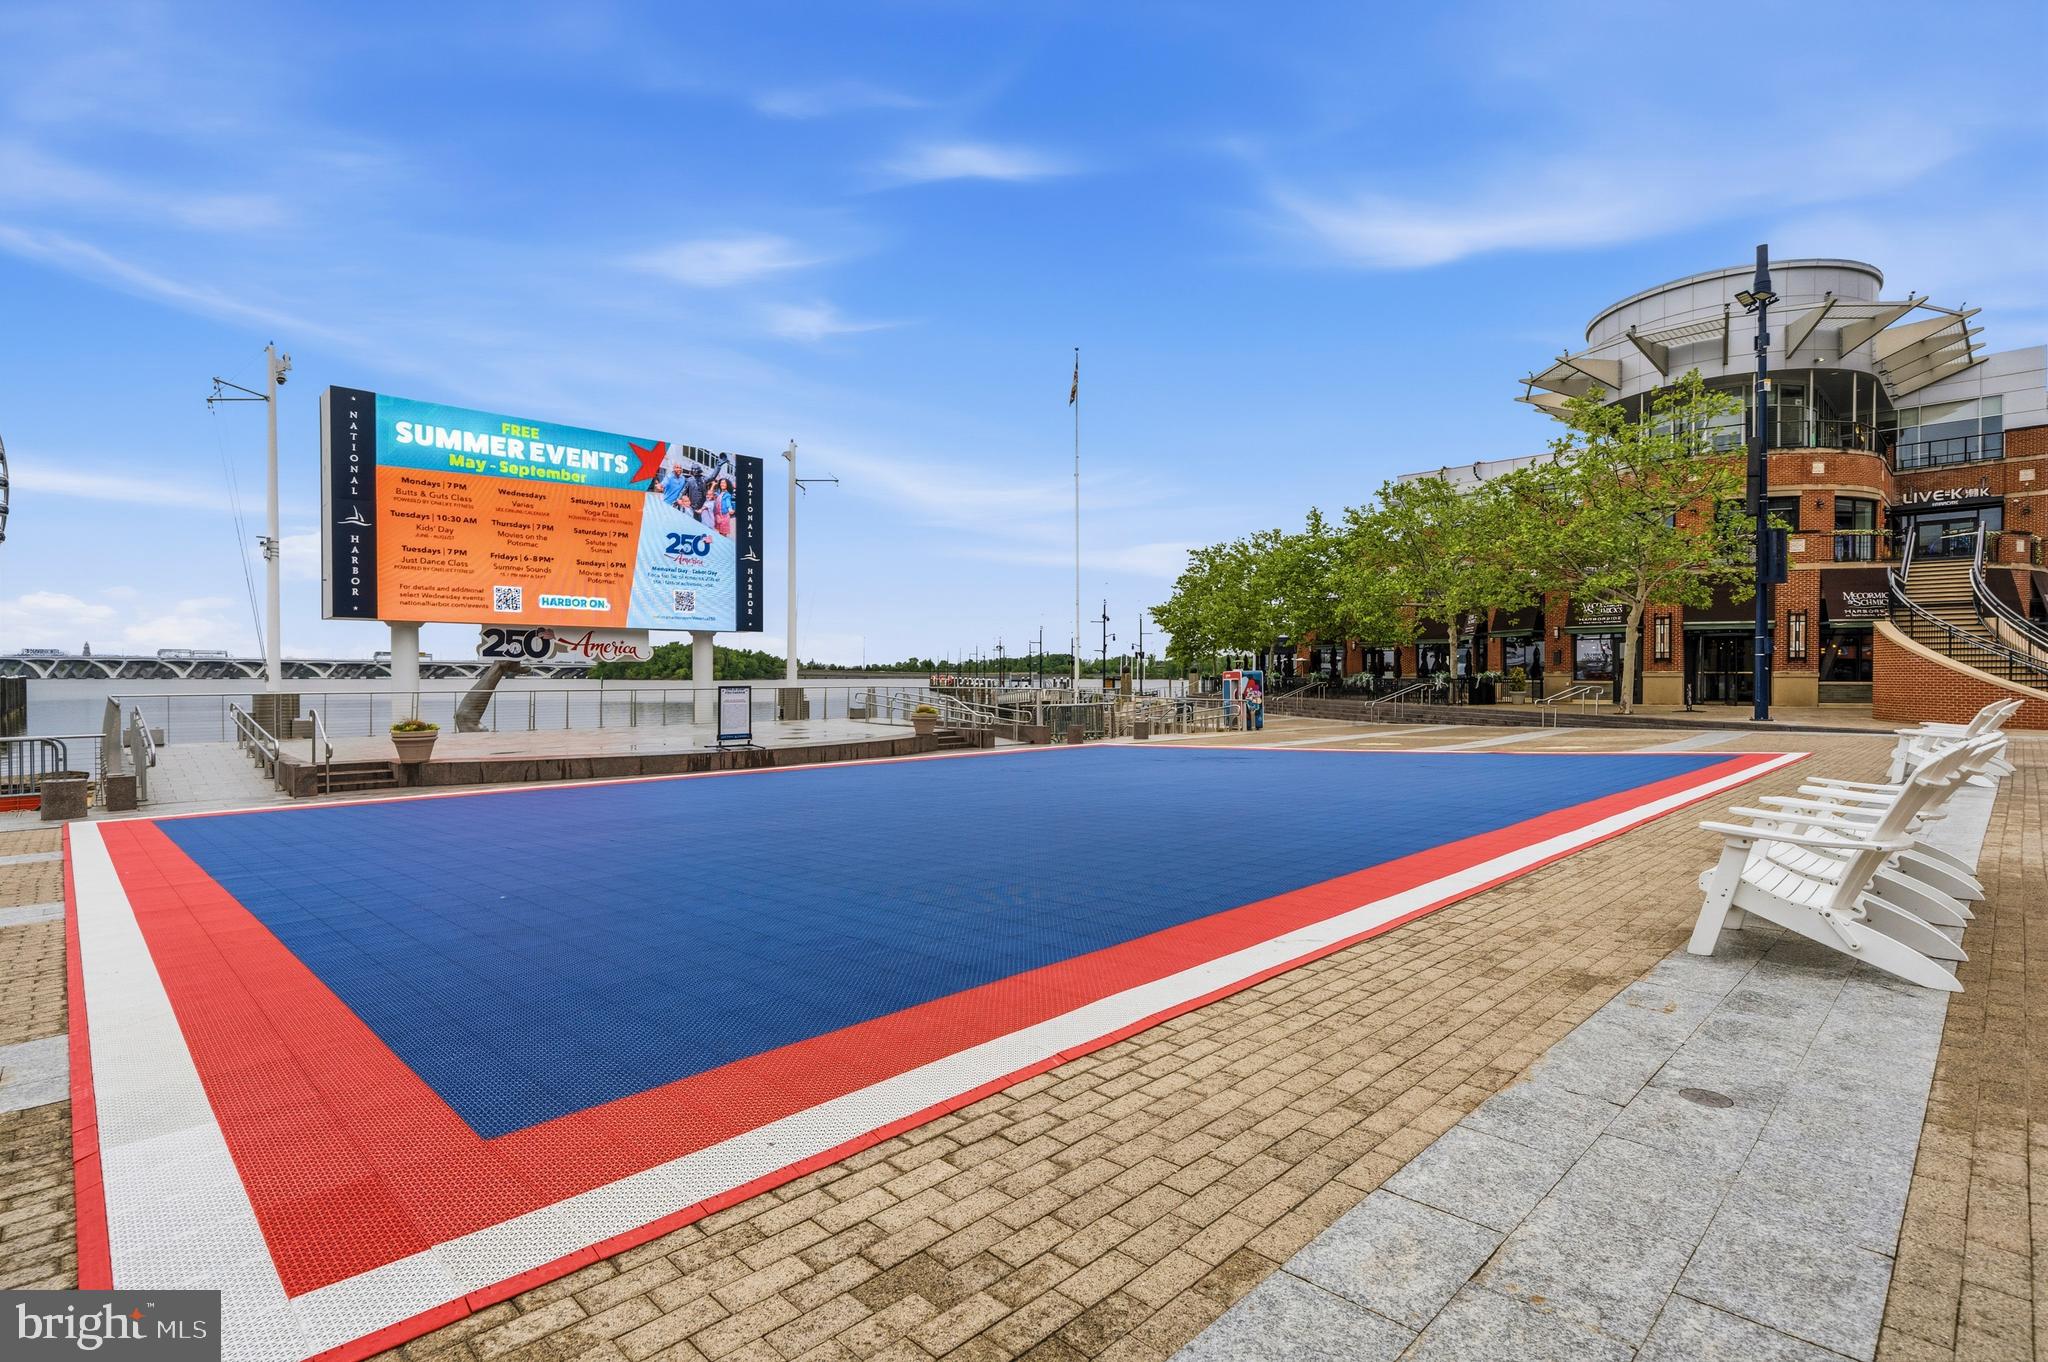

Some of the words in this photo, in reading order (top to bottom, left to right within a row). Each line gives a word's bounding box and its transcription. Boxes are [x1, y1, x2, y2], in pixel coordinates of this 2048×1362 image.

[501, 422, 540, 439] FREE
[349, 411, 359, 495] NATIONAL
[395, 421, 525, 460] SUMMER
[529, 441, 628, 474] EVENTS
[449, 453, 487, 473] May
[499, 461, 587, 483] September
[401, 477, 440, 488] Mondays
[395, 487, 417, 497] Butts
[429, 491, 449, 500] Guts
[451, 493, 472, 502] Class
[498, 488, 547, 501] Wednesdays
[570, 497, 605, 508] Saturdays
[390, 509, 430, 521] Tuesdays
[437, 514, 461, 523] 10:30
[584, 509, 600, 517] Yoga
[602, 510, 619, 518] Class
[437, 525, 454, 535] Day
[491, 519, 530, 530] Thursdays
[497, 530, 523, 539] Movies
[536, 533, 548, 541] the
[573, 527, 608, 538] Saturdays
[507, 539, 539, 548] Potomac
[585, 538, 606, 546] Salute
[665, 532, 711, 556] 250
[401, 544, 441, 556] Tuesdays
[401, 556, 418, 564] Just
[420, 557, 445, 566] Dance
[447, 559, 468, 567] Class
[490, 552, 518, 562] Fridays
[350, 535, 360, 596] HARBOR
[493, 563, 524, 571] Summer
[525, 564, 552, 574] Sounds
[576, 559, 605, 568] Sundays
[579, 569, 602, 577] Movies
[421, 592, 460, 601] Wednesday
[1842, 591, 1889, 601] McCORMIC
[400, 600, 489, 609] nationalharbor.com/events
[541, 597, 587, 608] HARBOR
[1853, 598, 1889, 607] SCHMIC
[482, 628, 551, 659] 250
[558, 630, 651, 661] America
